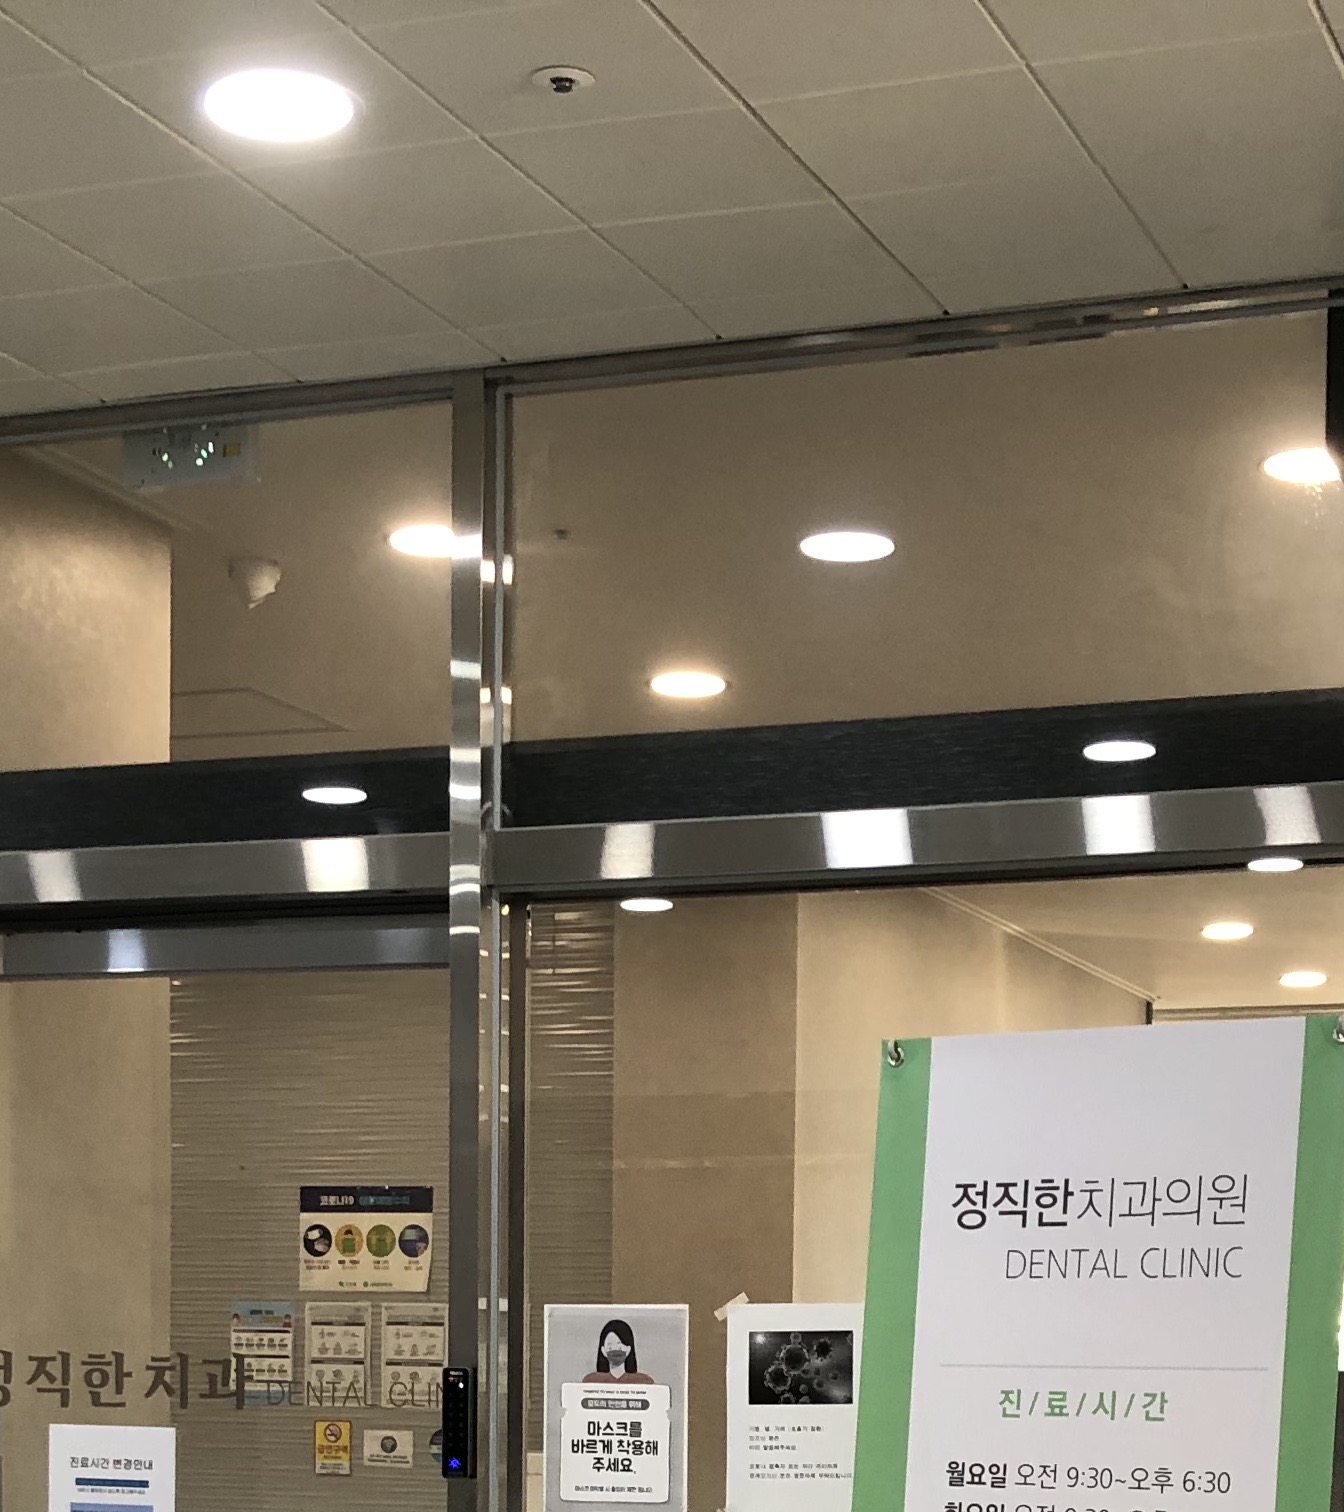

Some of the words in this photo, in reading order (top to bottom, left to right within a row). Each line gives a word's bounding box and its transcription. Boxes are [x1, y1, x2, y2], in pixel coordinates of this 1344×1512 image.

[952, 1174, 1248, 1229] 정직한치과의원
[1005, 1248, 1127, 1279] DENTAL
[1139, 1246, 1243, 1278] CLINIC
[998, 1388, 1168, 1421] 진/료/시/간
[587, 1421, 642, 1437] 마스크를
[571, 1439, 612, 1454] 바르게
[617, 1439, 658, 1456] 착용해
[70, 1457, 109, 1469] 진료시간
[592, 1457, 636, 1474] 주세요.
[946, 1461, 1007, 1489] 월요일
